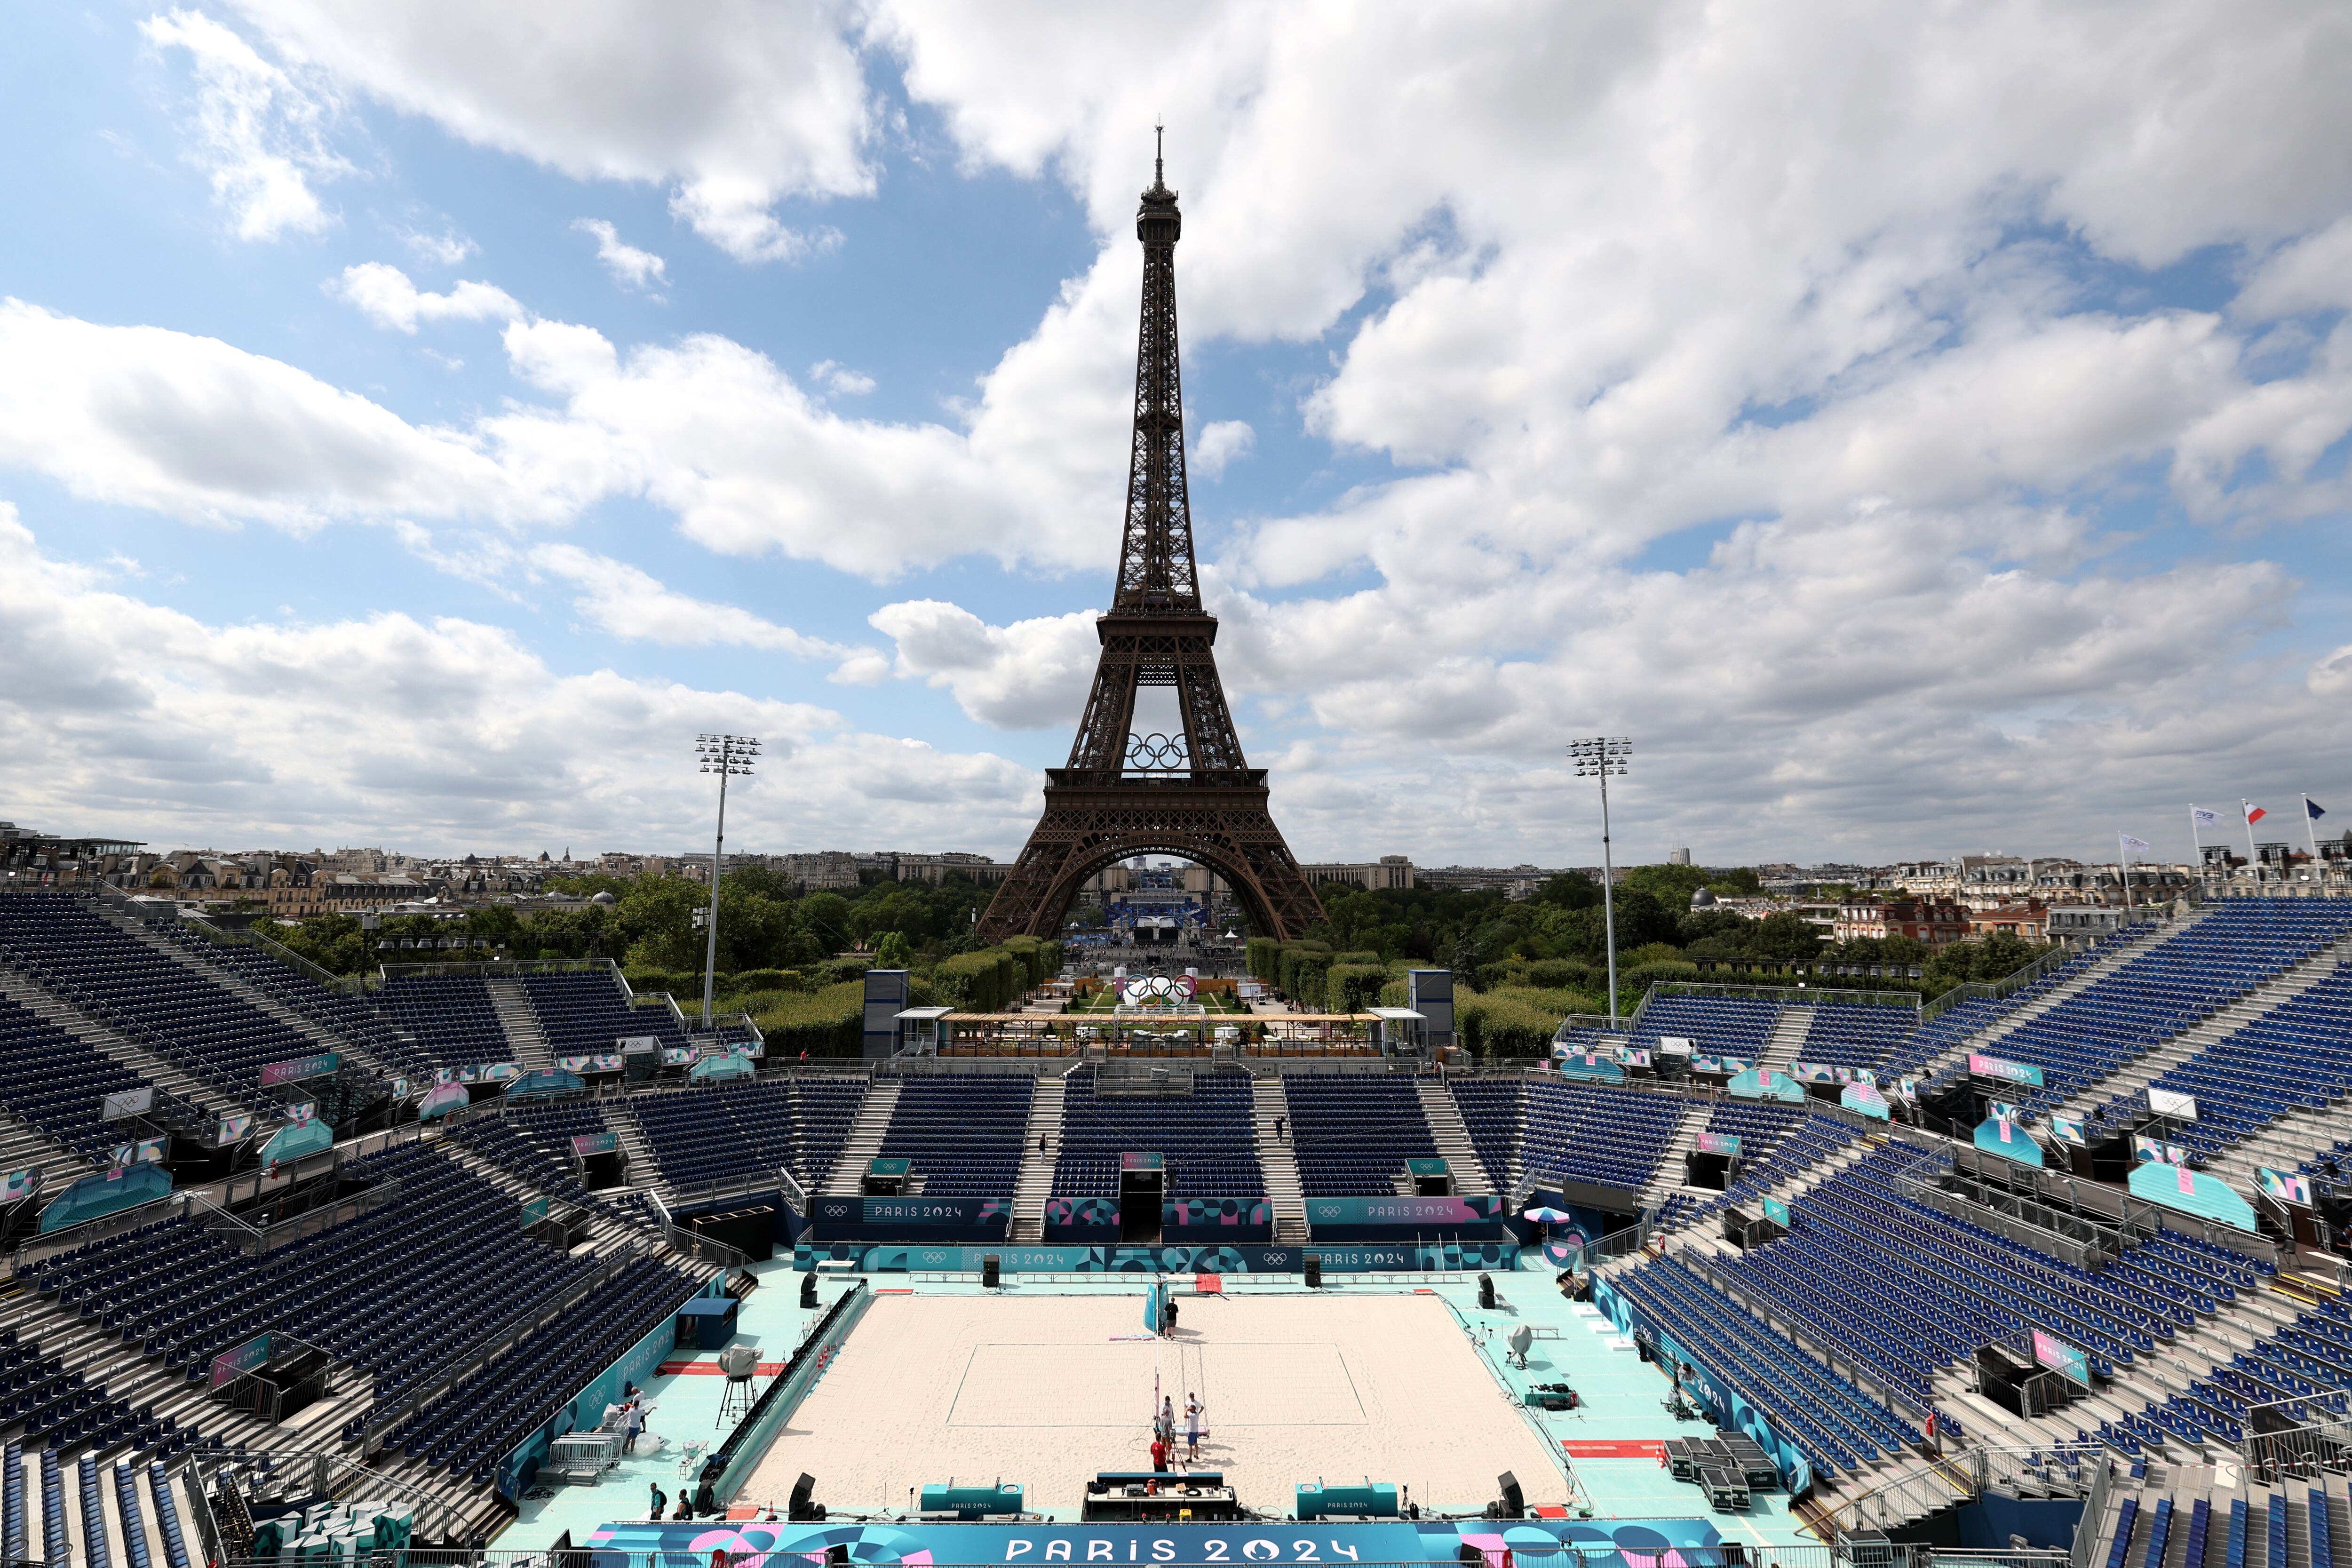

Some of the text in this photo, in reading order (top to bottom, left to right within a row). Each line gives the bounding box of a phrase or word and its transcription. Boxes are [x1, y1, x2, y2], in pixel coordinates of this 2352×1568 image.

[305, 1060, 327, 1072] 2024
[2006, 1066, 2032, 1079] 2024
[923, 1207, 961, 1217] 2024
[1416, 1206, 1453, 1216] 2024
[1024, 1254, 1064, 1265] 2024
[1365, 1253, 1404, 1264] 2024
[653, 1327, 674, 1354] 2024
[244, 1346, 264, 1361] 2024
[1698, 1378, 1725, 1413] 2024
[1204, 1539, 1359, 1561] 2024
